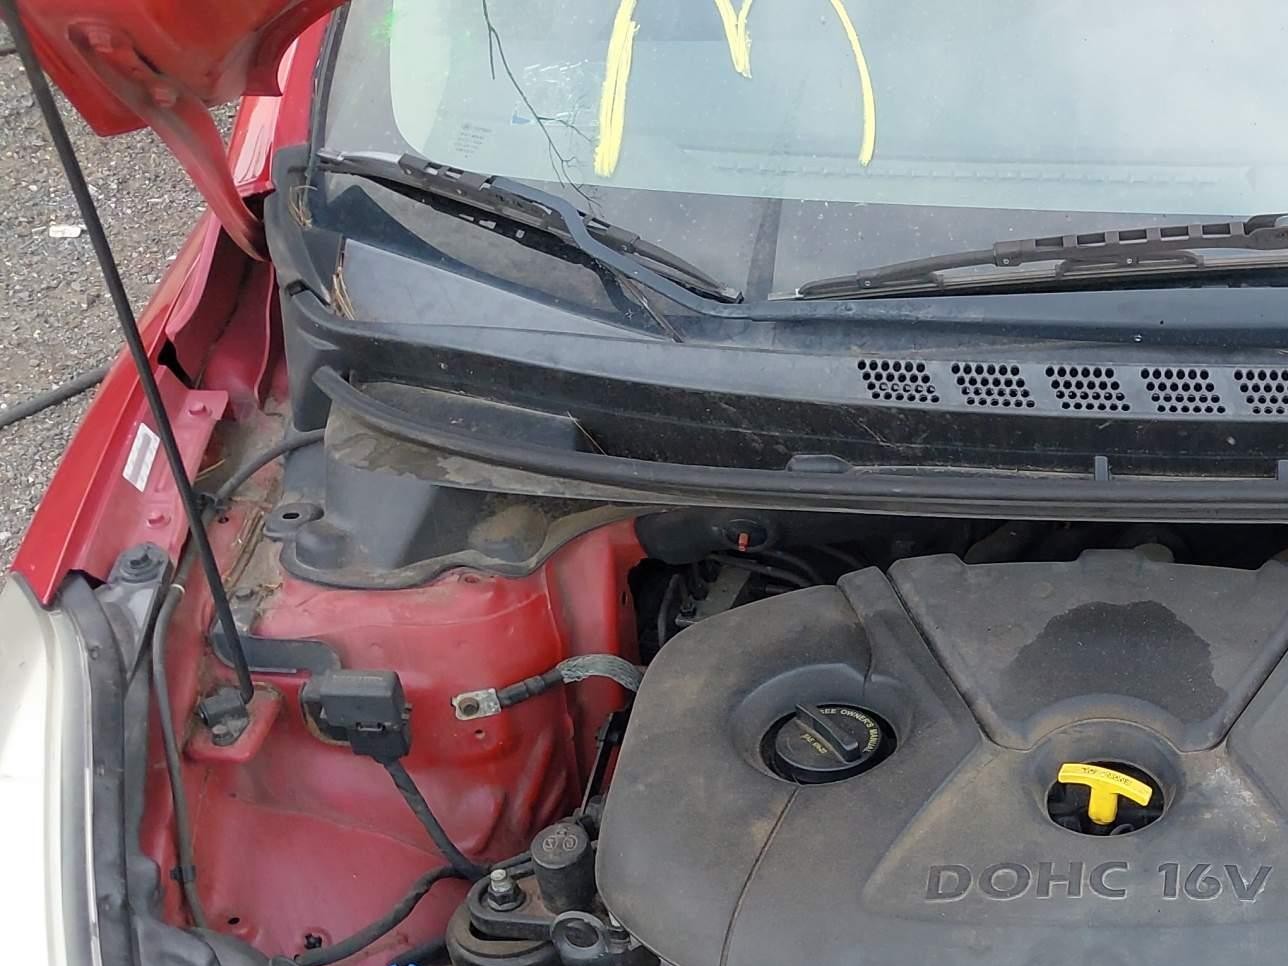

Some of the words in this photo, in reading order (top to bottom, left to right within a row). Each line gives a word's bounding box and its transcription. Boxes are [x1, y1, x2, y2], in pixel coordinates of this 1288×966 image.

[840, 709, 875, 728] OWNER'S
[862, 728, 879, 753] MANUAL
[925, 861, 1130, 903] DOHC
[1157, 862, 1273, 903] 16V
